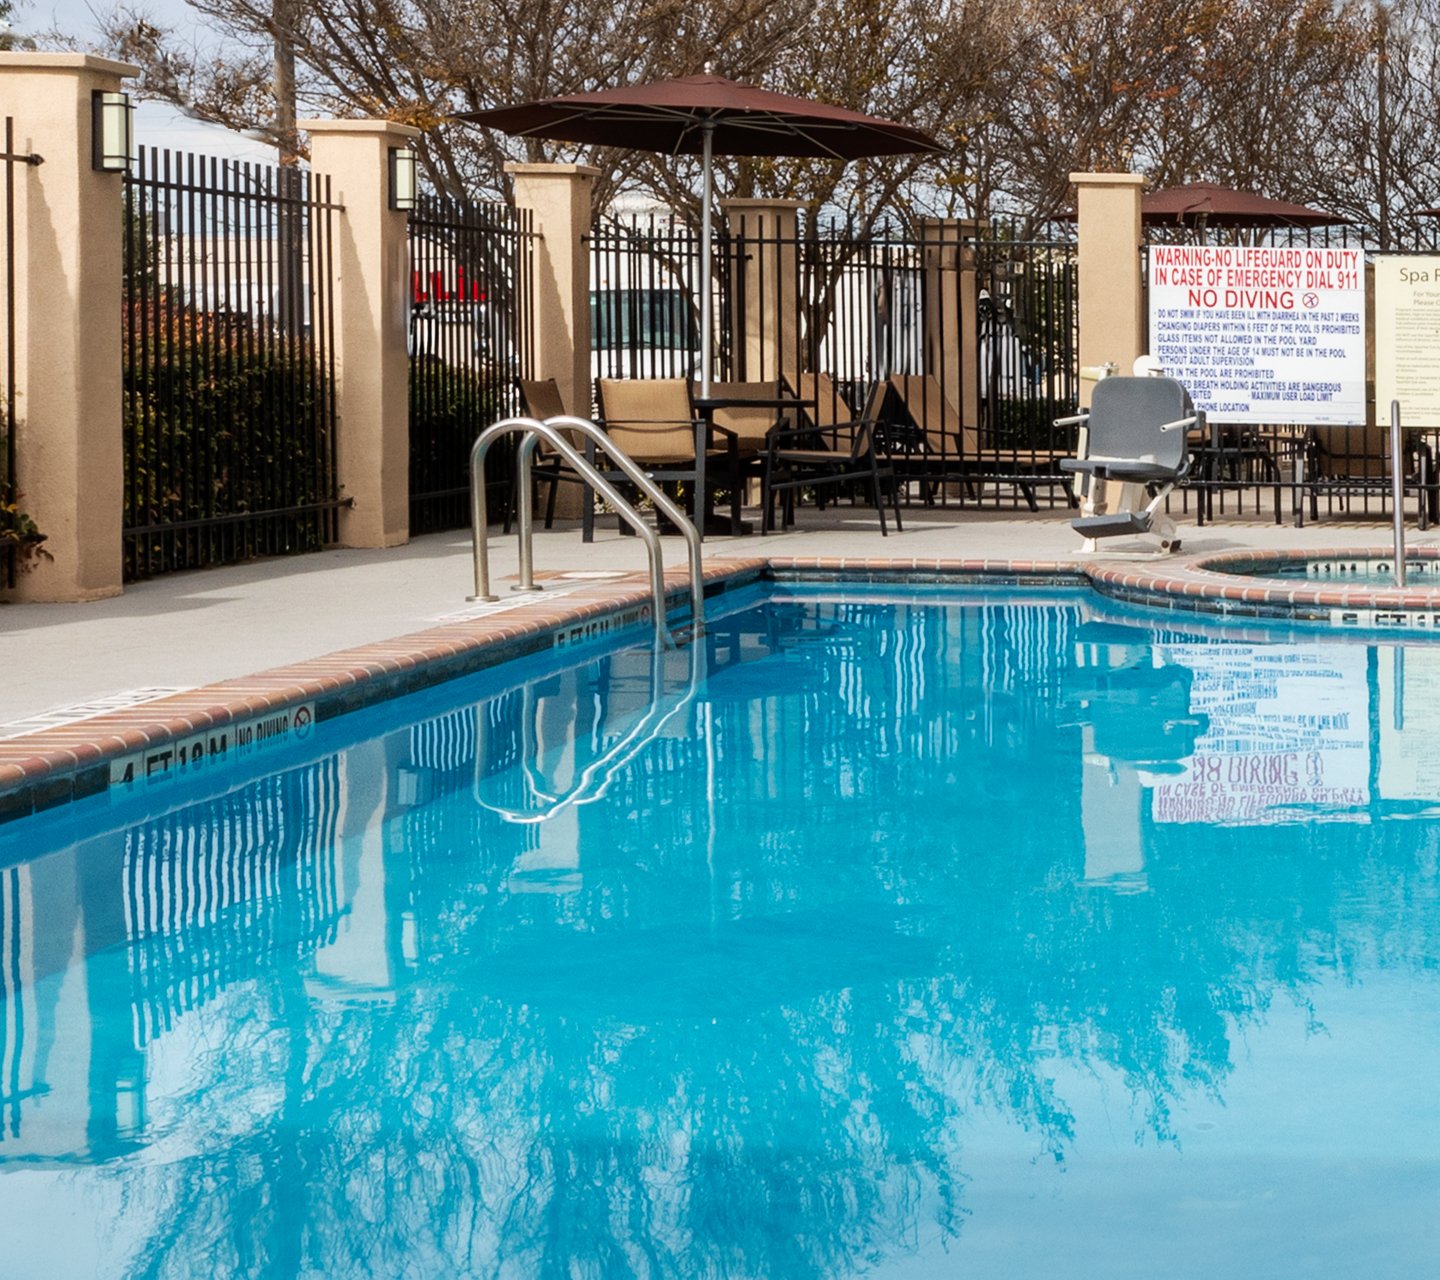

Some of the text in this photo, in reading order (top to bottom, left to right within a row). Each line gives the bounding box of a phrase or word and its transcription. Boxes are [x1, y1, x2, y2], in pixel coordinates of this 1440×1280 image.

[1236, 249, 1301, 268] LIFEGUARD
[1306, 251, 1322, 268] ON
[1327, 251, 1358, 269] DUTY
[1155, 268, 1357, 289] IN CASE OF EMERGENCY DIAL 911
[1399, 267, 1429, 285] Spa
[1189, 289, 1294, 310] NO DIVING
[1158, 309, 1165, 318] DO
[1168, 309, 1178, 318] NOT
[1180, 309, 1194, 318] SWIM
[1196, 310, 1200, 318] IF
[1203, 310, 1213, 318] YOU
[1216, 310, 1229, 319] HAVE
[1231, 310, 1245, 319] BEEN
[1247, 310, 1255, 319] ILL
[1257, 311, 1270, 320] WITH
[1272, 311, 1299, 321] DIARRHEA
[1301, 312, 1307, 321] IN
[1309, 312, 1319, 321] THE
[1321, 312, 1334, 321] PAST
[1341, 313, 1359, 322] WEEKS
[1158, 322, 1191, 331] CHANGING
[1193, 322, 1220, 331] DIAPERS
[1223, 322, 1245, 332] WITHIN
[1253, 323, 1268, 332] FEET
[1270, 323, 1278, 332] OF
[1280, 324, 1293, 333] THE
[1295, 324, 1312, 333] POOL
[1314, 324, 1320, 333] IS
[1321, 324, 1360, 334] PROHIBITED
[1158, 334, 1317, 345] GLASS ITEMS NOT ALLOWED IN THE POOL YARD
[1158, 345, 1346, 358] PERSONS UNDER THE AGE OF 14 MUST NOT BE IN THE POOL
[1158, 355, 1254, 365] WITHOUT ADULT SUPERVISION
[1177, 368, 1183, 377] IN
[1185, 368, 1198, 377] THE
[1200, 368, 1218, 377] POOL
[1220, 369, 1232, 378] ARE
[1234, 369, 1274, 379] PROHIBITED
[1193, 380, 1218, 389] BREATH
[1220, 380, 1249, 390] HOLDING
[1251, 381, 1286, 391] ACTIVITIES
[1288, 382, 1300, 391] ARE
[1302, 382, 1342, 392] DANGEROUS
[1251, 391, 1333, 401] MAXIMUM USER LOAD LIMIT
[1197, 402, 1249, 412] PHONE LOCATION
[147, 750, 172, 777] FT
[210, 734, 226, 756] M
[239, 727, 252, 748] NO
